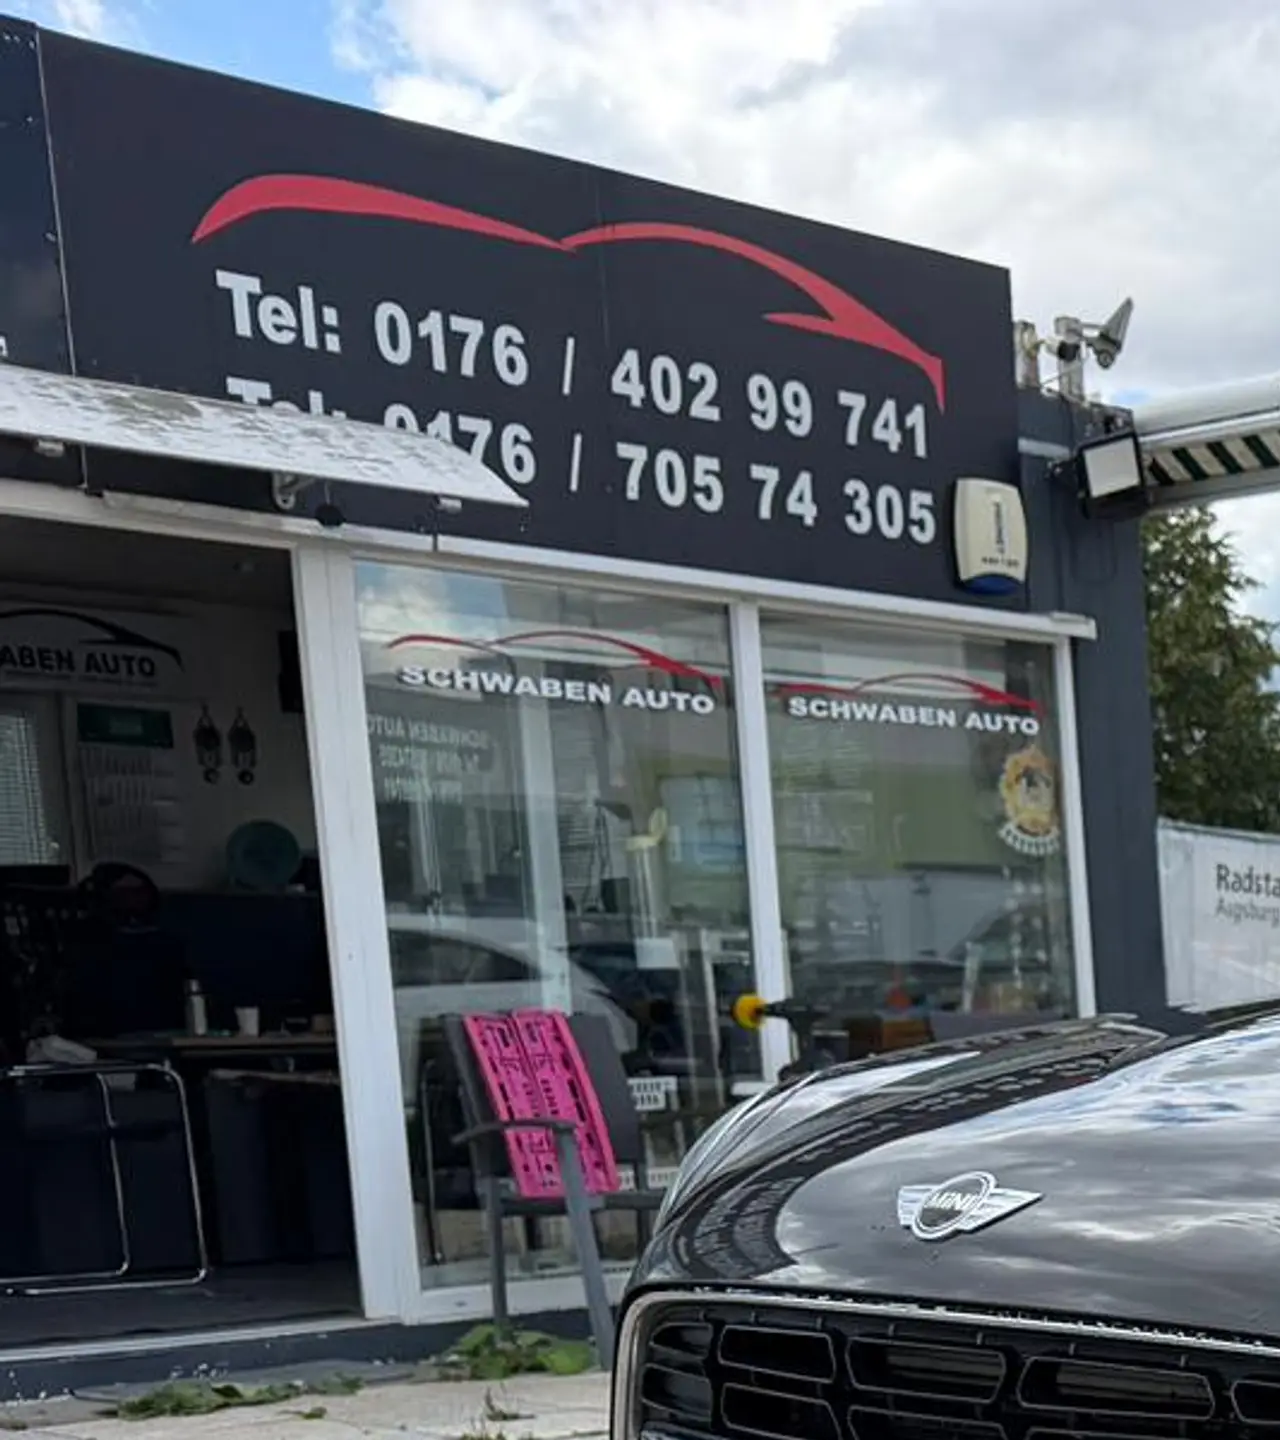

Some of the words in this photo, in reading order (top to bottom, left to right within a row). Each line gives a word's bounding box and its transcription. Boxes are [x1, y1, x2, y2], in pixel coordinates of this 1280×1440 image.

[216, 270, 341, 353] Tel:
[375, 302, 528, 386] 0176
[562, 337, 575, 395] /
[611, 349, 720, 422] 402
[747, 374, 812, 437] 99
[838, 390, 926, 458] 741
[570, 433, 582, 492] /
[616, 442, 724, 512] 705
[750, 464, 817, 526] 74
[844, 479, 935, 544] 305
[85, 651, 156, 677] AUTO
[400, 664, 612, 704] SCHWABEN
[622, 686, 715, 714] AUTO
[788, 696, 957, 728] SCHWABEN
[964, 711, 1040, 736] AUTO
[1215, 897, 1280, 927] Augsburg
